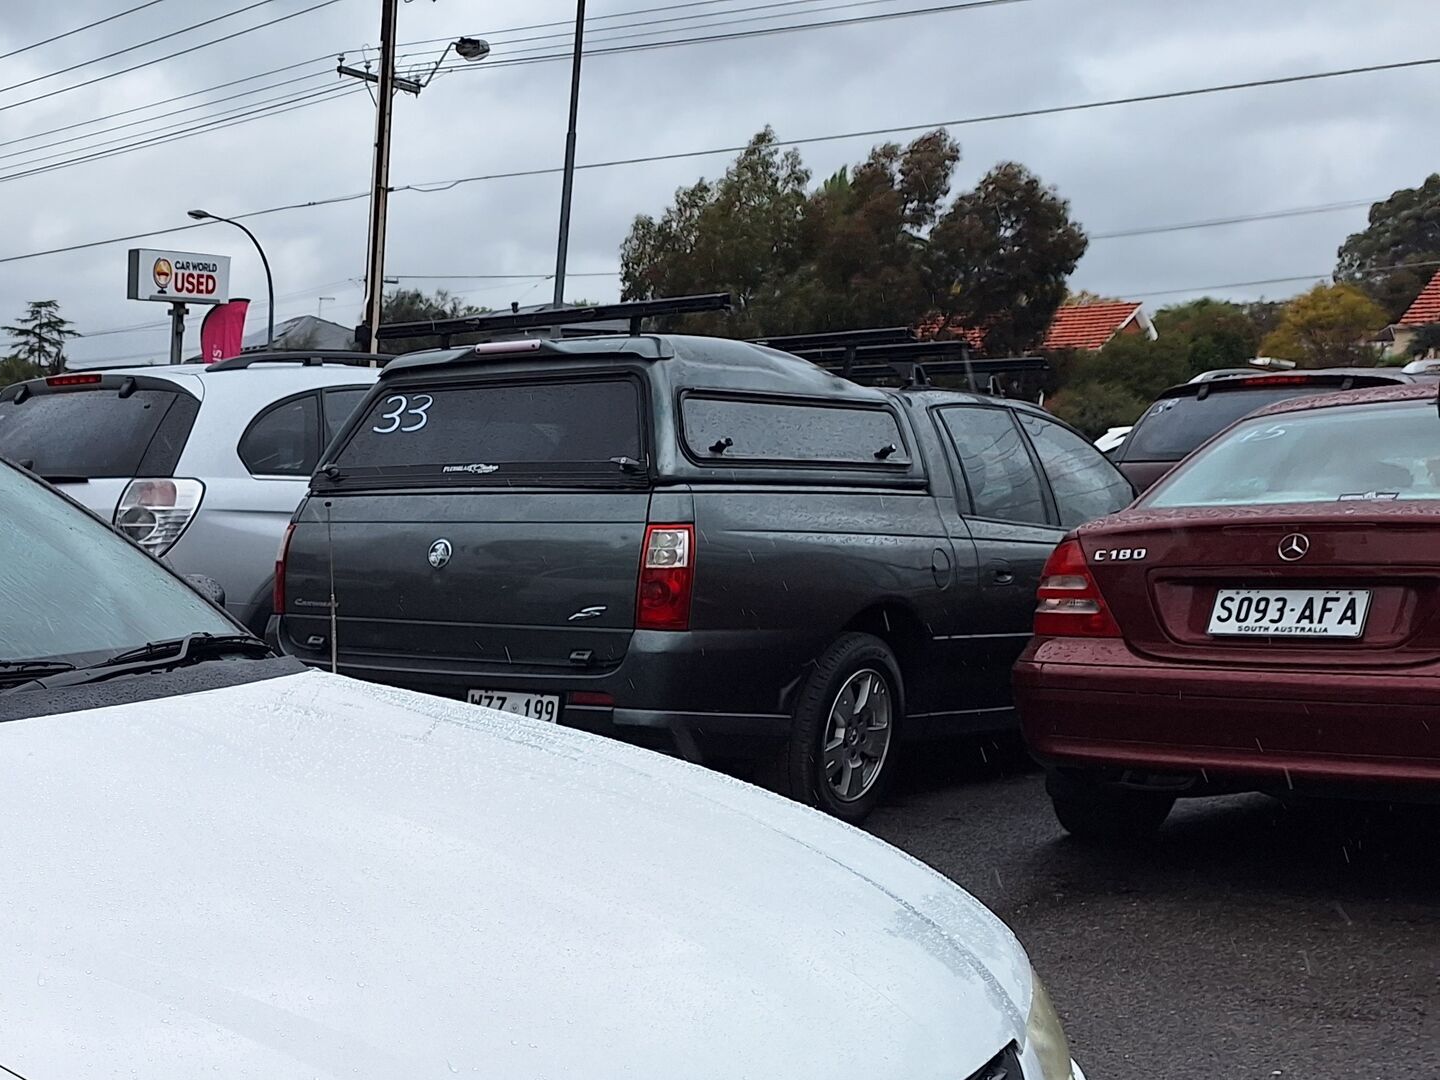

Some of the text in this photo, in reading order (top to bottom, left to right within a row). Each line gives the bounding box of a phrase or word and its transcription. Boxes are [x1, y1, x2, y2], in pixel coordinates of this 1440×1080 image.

[174, 260, 217, 272] CAR WORLD
[174, 272, 216, 294] USED
[372, 394, 433, 433] 33
[1237, 625, 1329, 634] SOUTH AUSTRALIA
[524, 698, 555, 721] 199
